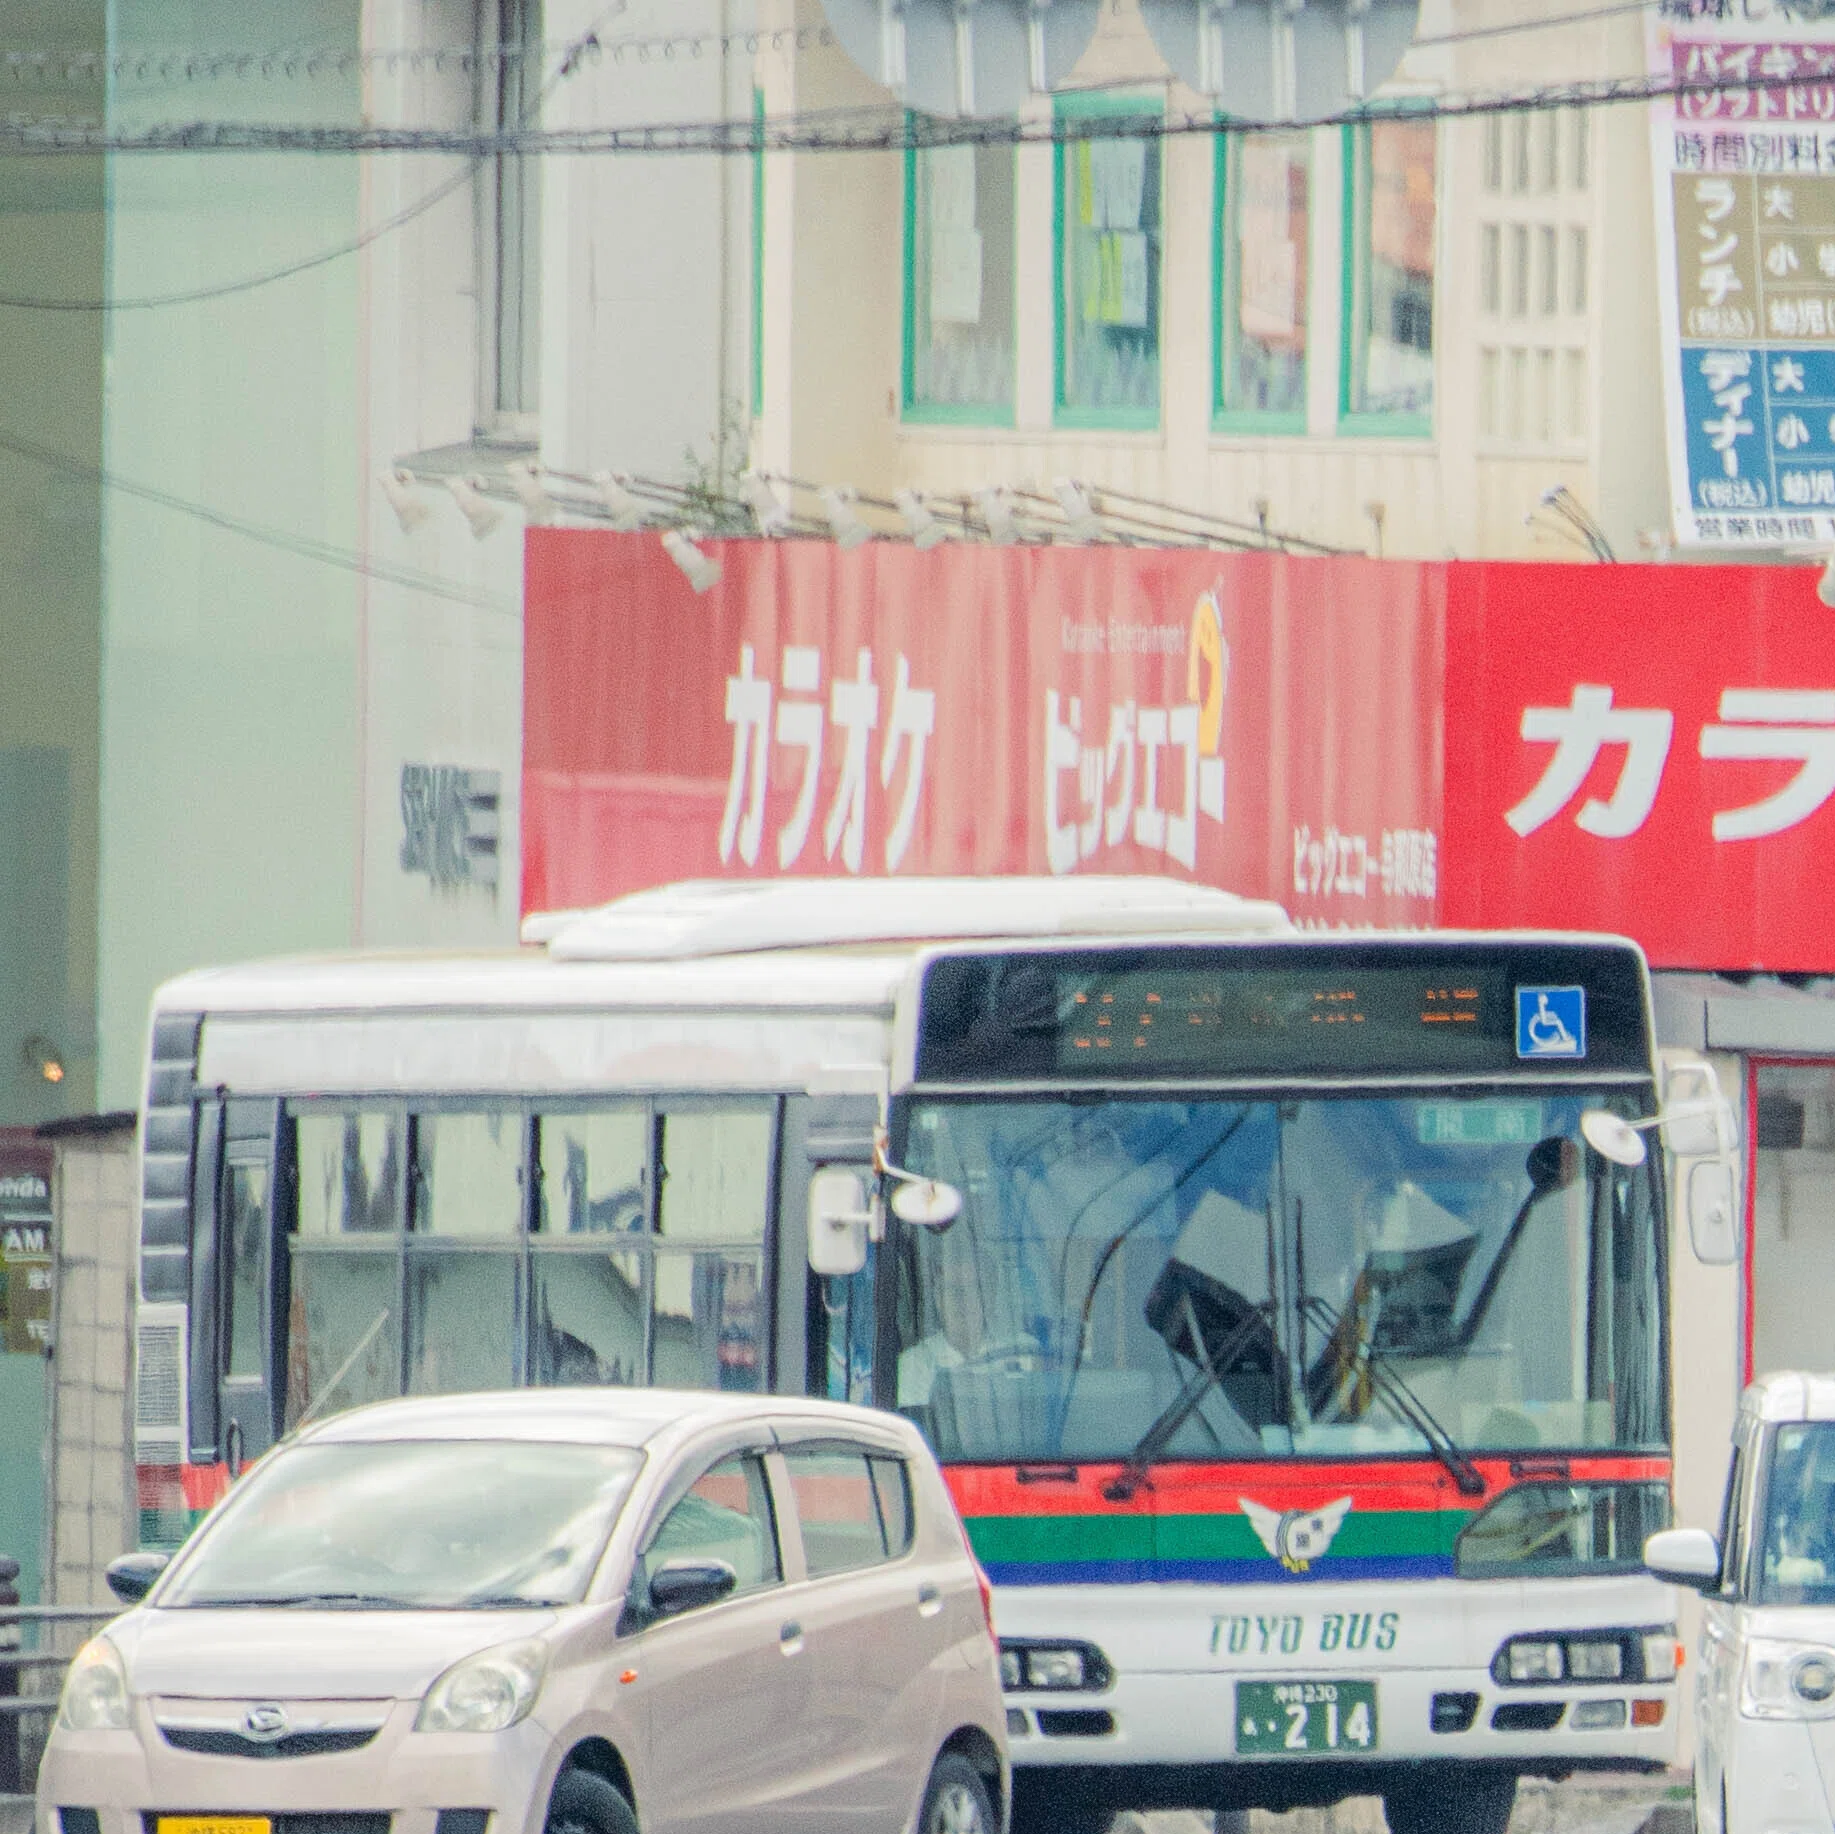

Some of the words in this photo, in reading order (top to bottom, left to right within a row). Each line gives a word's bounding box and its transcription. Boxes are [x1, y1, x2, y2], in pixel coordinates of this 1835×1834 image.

[1695, 178, 1743, 305] ランチ
[1701, 351, 1753, 478] ディナー
[718, 640, 936, 872] カラオケ
[1045, 687, 1225, 874] ビッグエコー
[1209, 1614, 1305, 1655] TOYO
[1318, 1611, 1400, 1652] BUS
